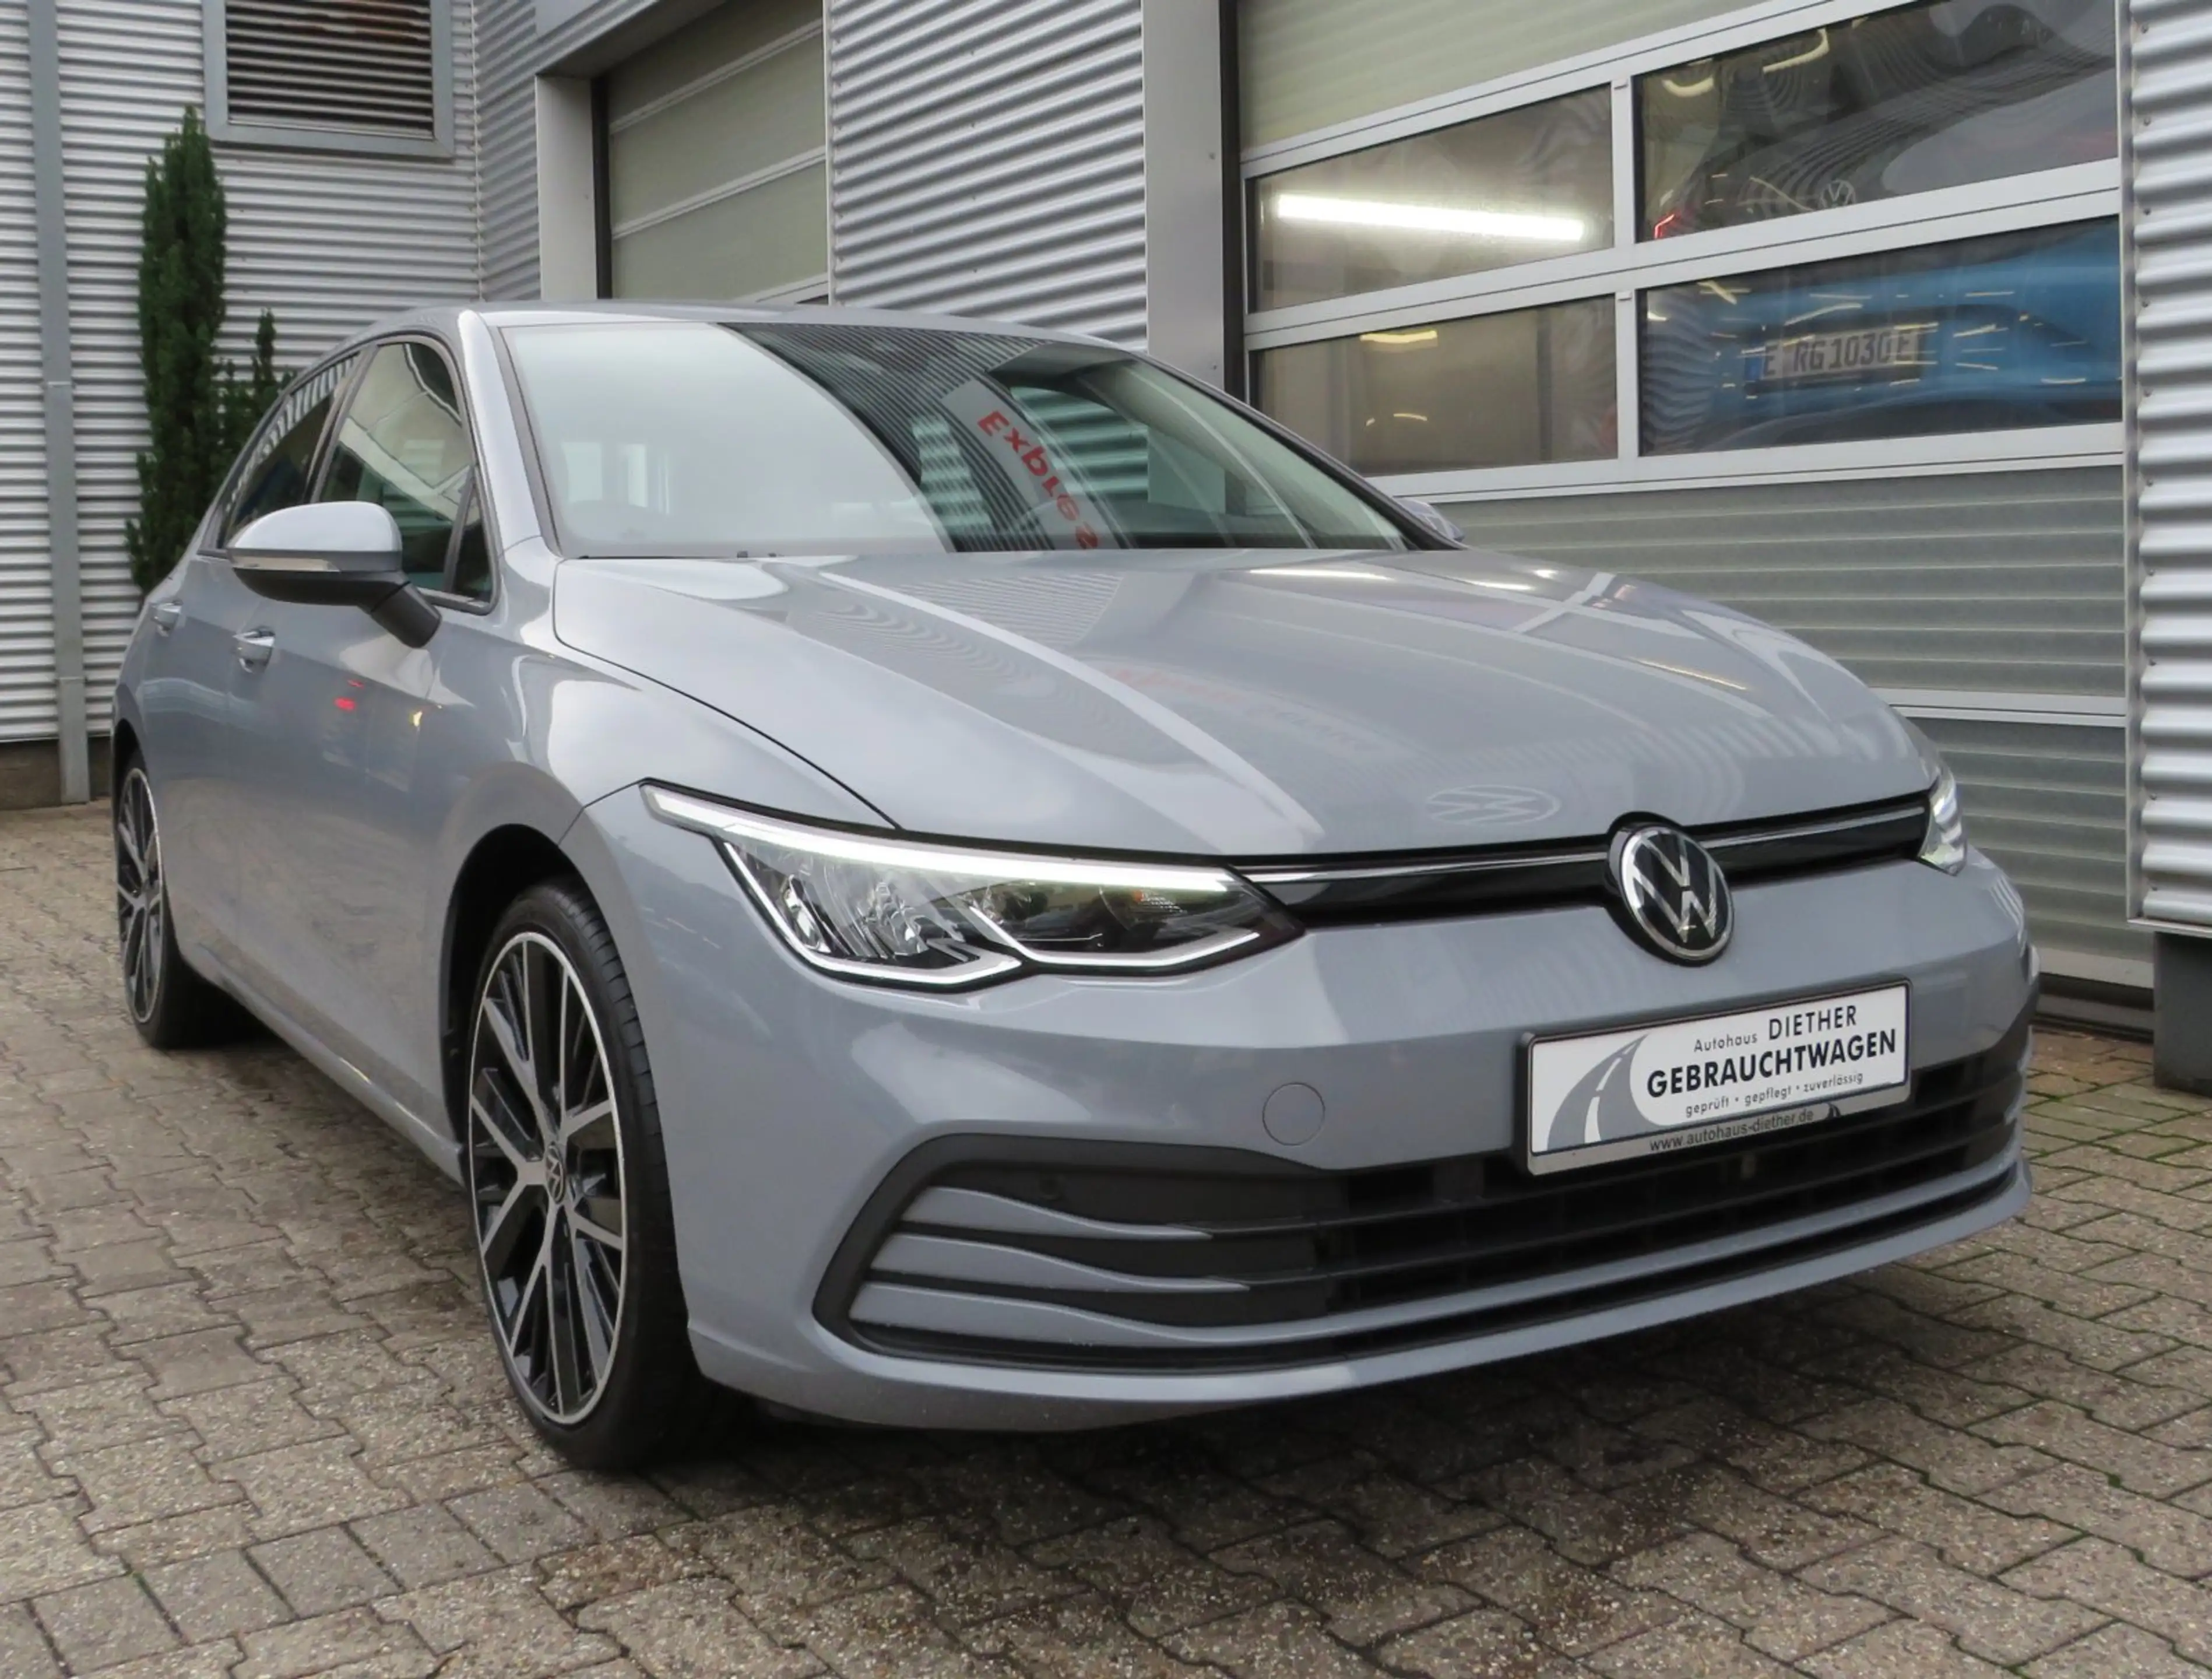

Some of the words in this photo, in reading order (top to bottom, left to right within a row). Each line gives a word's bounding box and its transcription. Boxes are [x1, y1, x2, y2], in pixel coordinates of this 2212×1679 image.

[1625, 828, 1730, 954] VW
[1694, 1033, 1757, 1053] Autohaus
[1768, 1004, 1857, 1041] DIETHER
[1647, 1028, 1896, 1098] GEBRAUCHTWAGEN
[1685, 1095, 1729, 1118] geprüft
[1744, 1086, 1792, 1107] gepflegt
[1803, 1072, 1863, 1093] zuverlässig
[1650, 1108, 1814, 1151] www.autohaus-diether.de
